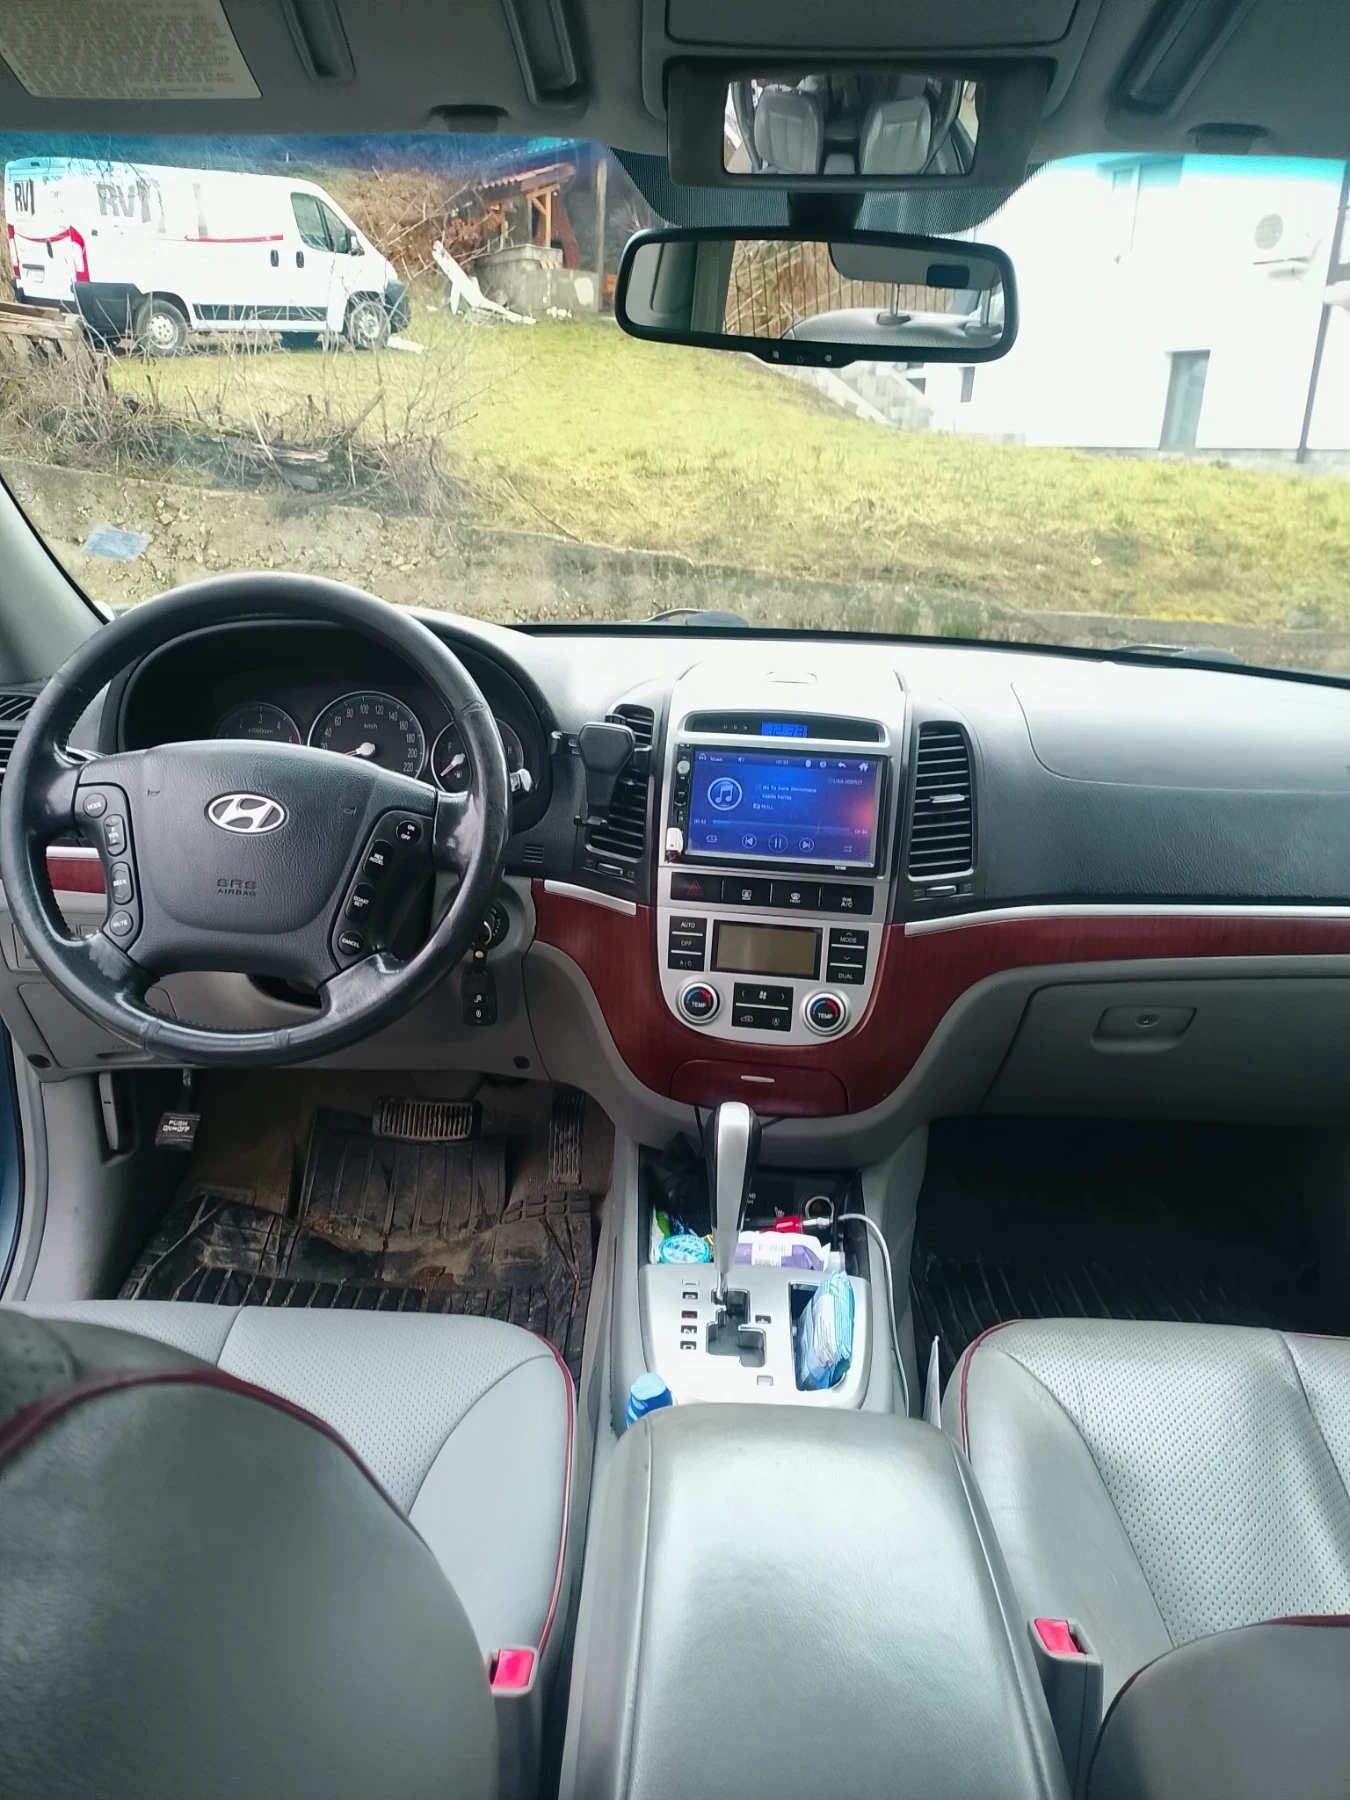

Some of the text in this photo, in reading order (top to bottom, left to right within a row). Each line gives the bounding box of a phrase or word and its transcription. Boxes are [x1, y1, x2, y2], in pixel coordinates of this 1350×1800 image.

[346, 708, 353, 718] 80
[360, 704, 369, 714] 100
[375, 704, 384, 715] 120
[259, 714, 263, 724] 3
[334, 716, 341, 726] 60
[388, 711, 398, 722] 140
[240, 719, 244, 728] 2
[276, 721, 281, 730] 4
[399, 721, 408, 731] 160
[324, 728, 332, 737] 40
[406, 733, 415, 743] 180
[408, 748, 417, 758] 200
[403, 762, 414, 772] 220
[87, 802, 102, 810] MODE
[217, 879, 257, 890] SRS
[218, 889, 256, 897] AIRBAG
[342, 938, 360, 948] CANCEL
